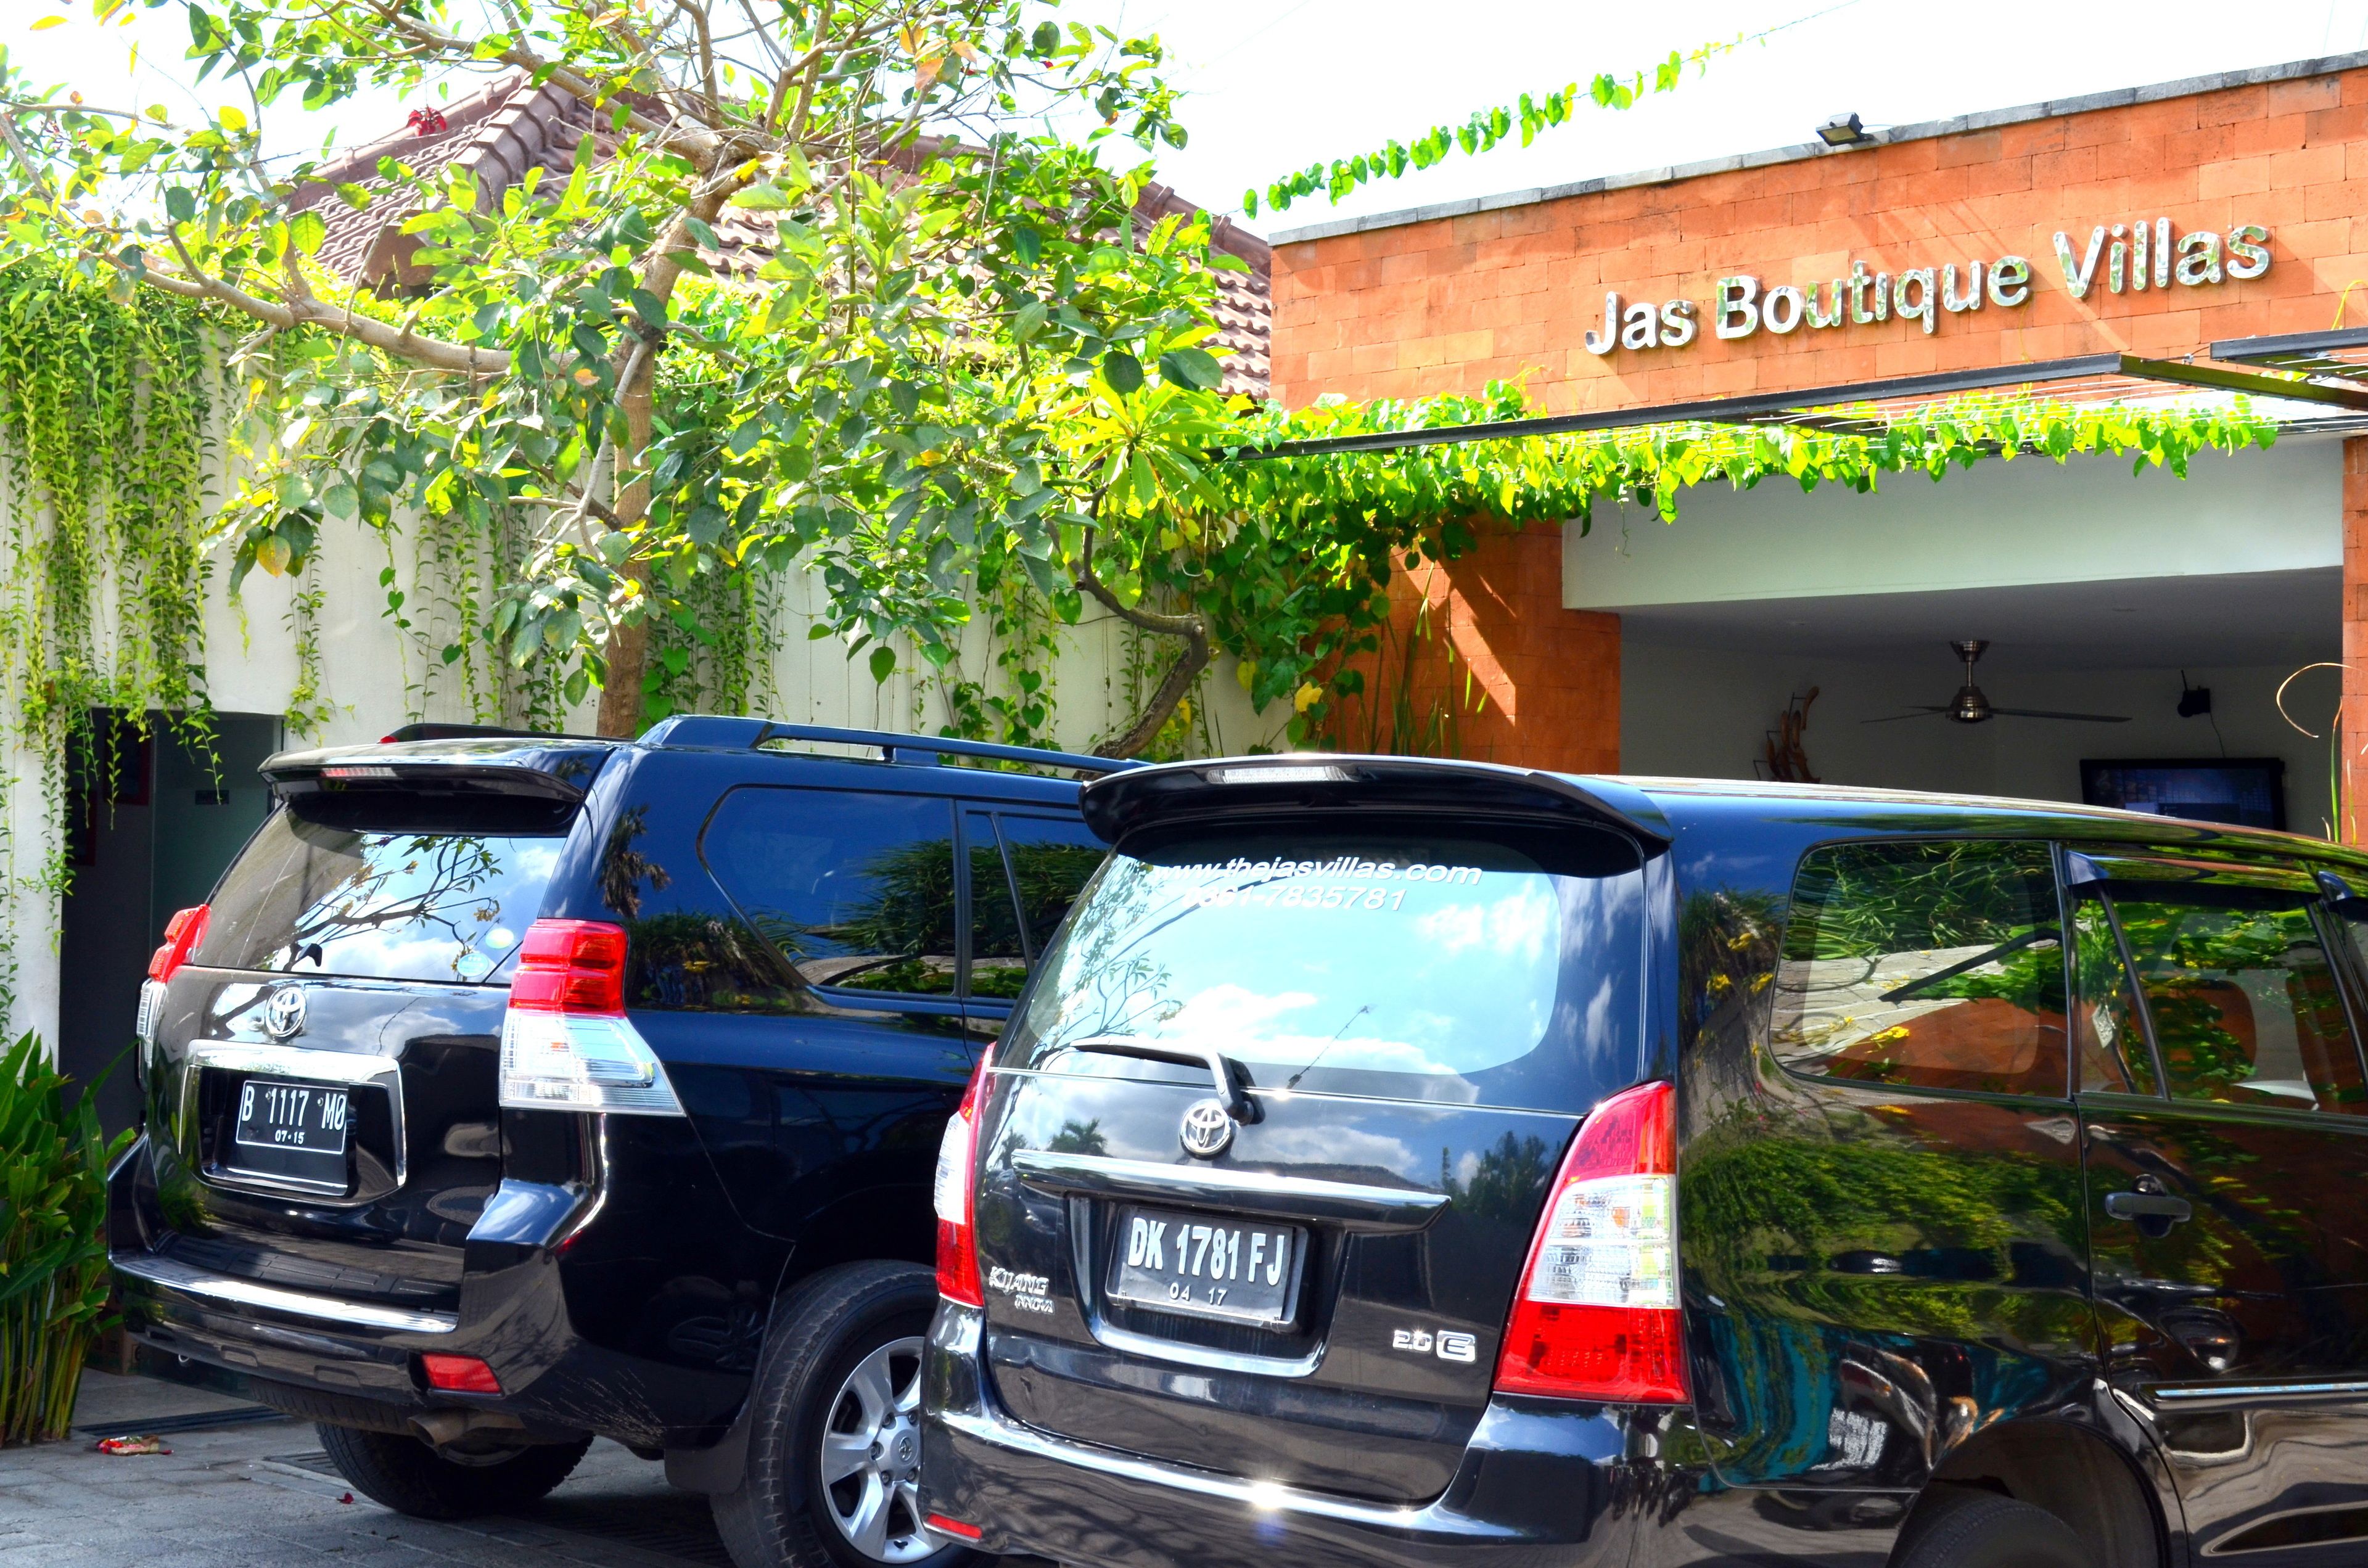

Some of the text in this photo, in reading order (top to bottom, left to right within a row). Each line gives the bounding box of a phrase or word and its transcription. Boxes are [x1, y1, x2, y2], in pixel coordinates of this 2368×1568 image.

[1585, 216, 2274, 355] Jas Boutique Villas
[1155, 856, 1482, 885] www.thejasvillas.com
[241, 1085, 255, 1122] B
[269, 1088, 309, 1127] 1117
[1128, 1217, 1285, 1286] DK 1781 FJ
[989, 1266, 1050, 1296] KIJANG
[1169, 1282, 1227, 1305] 04 17
[1014, 1294, 1055, 1315] INNOVA
[1392, 1329, 1433, 1353] 2.0
